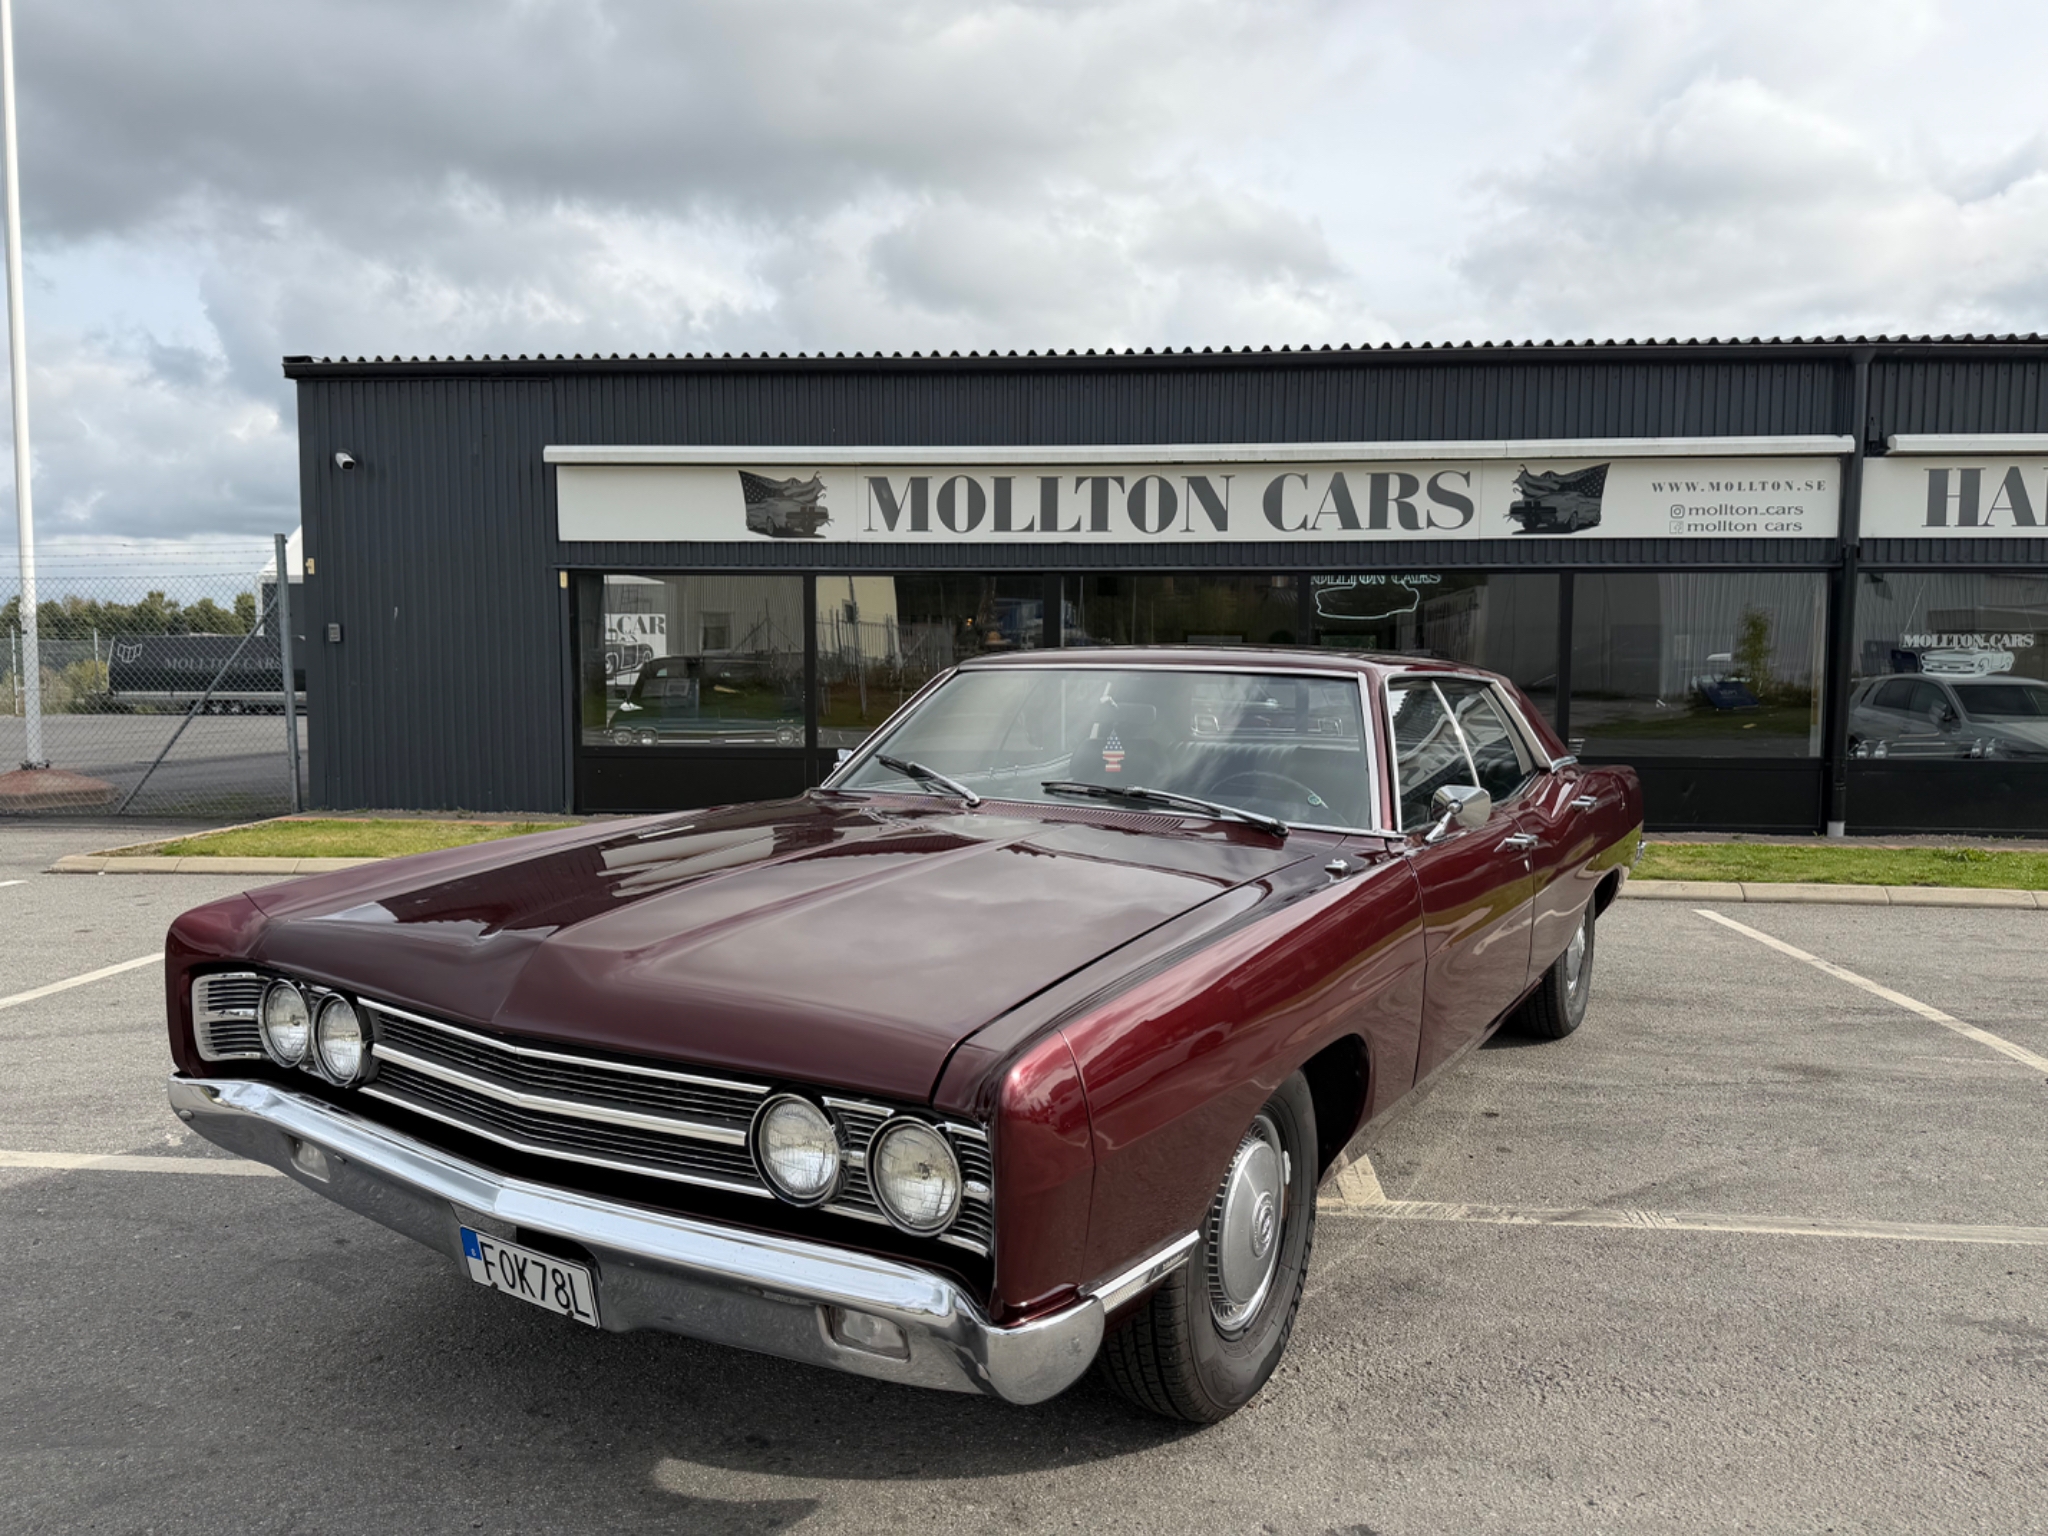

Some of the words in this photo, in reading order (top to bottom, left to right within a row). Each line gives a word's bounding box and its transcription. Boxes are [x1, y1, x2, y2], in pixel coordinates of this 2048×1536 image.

[1652, 480, 1827, 493] WWW.MOLLTON.SE
[863, 473, 1236, 535] MOLLTON
[1262, 470, 1475, 532] CARS
[1921, 465, 2048, 528] HA
[1688, 504, 1804, 516] mollton_cars
[1687, 520, 1757, 532] mollton
[1764, 521, 1803, 532] cars
[1902, 633, 1986, 648] MOLLTON
[1989, 633, 2035, 648] CARS
[479, 1241, 591, 1319] FOK78L
